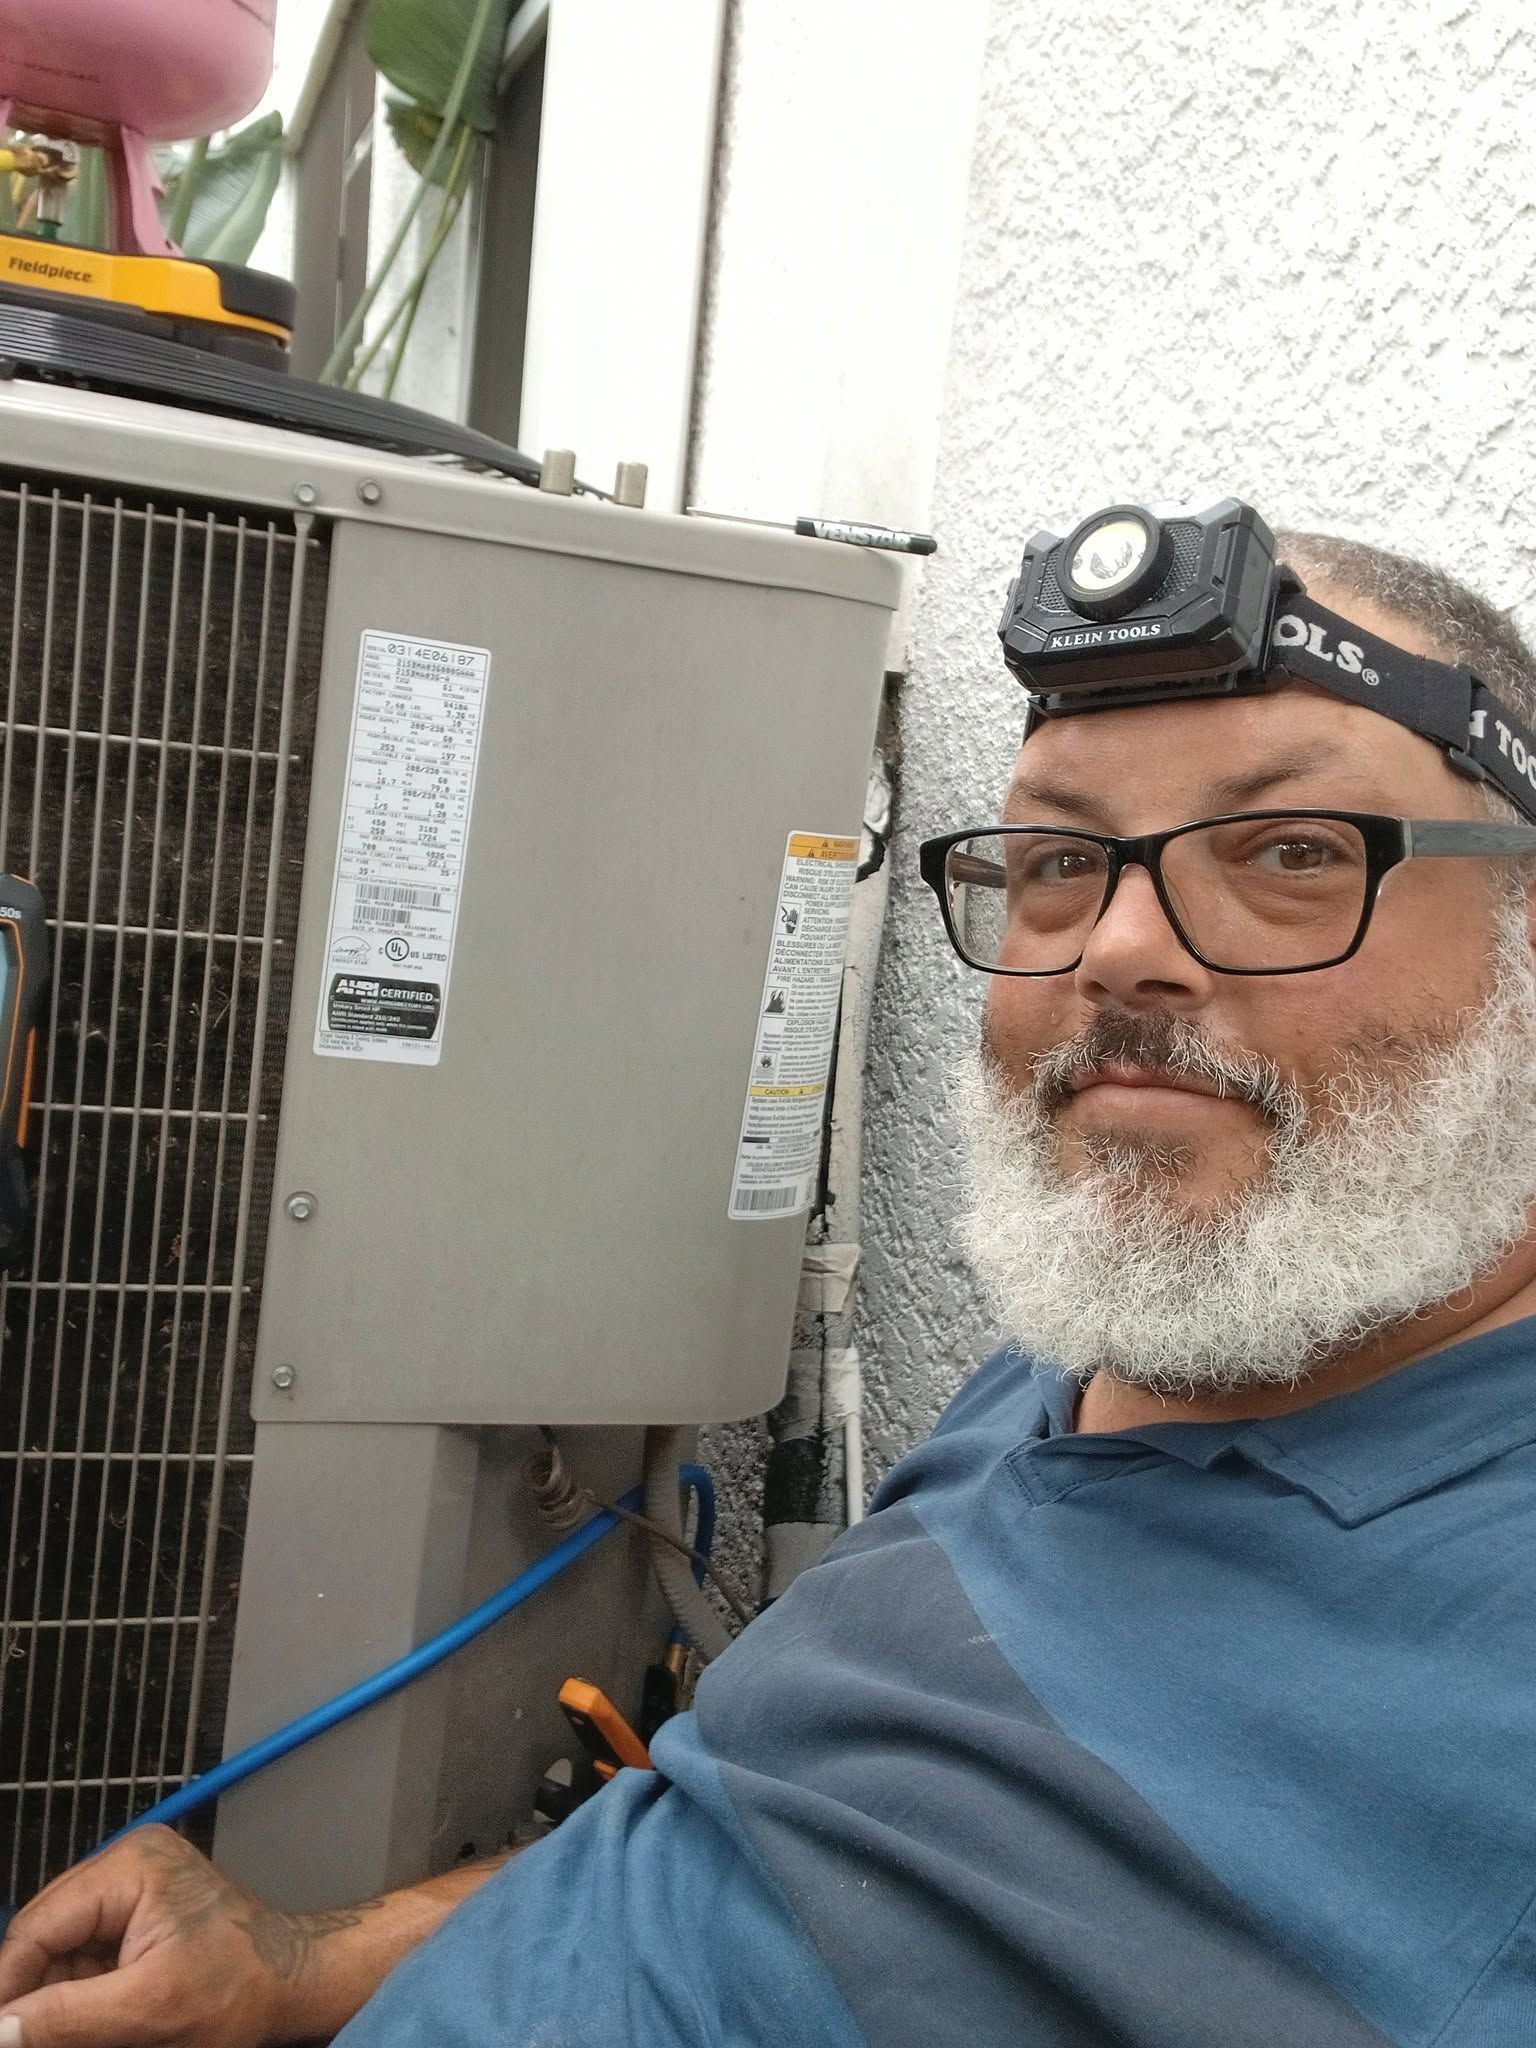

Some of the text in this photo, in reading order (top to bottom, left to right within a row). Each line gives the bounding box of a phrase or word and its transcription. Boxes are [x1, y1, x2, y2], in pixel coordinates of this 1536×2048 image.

[8, 256, 92, 283] Fieldpiece
[1051, 624, 1161, 649] KLEIN TOOLS
[796, 859, 833, 868] ELECTRICAL
[784, 882, 798, 890] CAN
[422, 953, 447, 962] LISTED
[381, 989, 433, 1002] CERTIFIED
